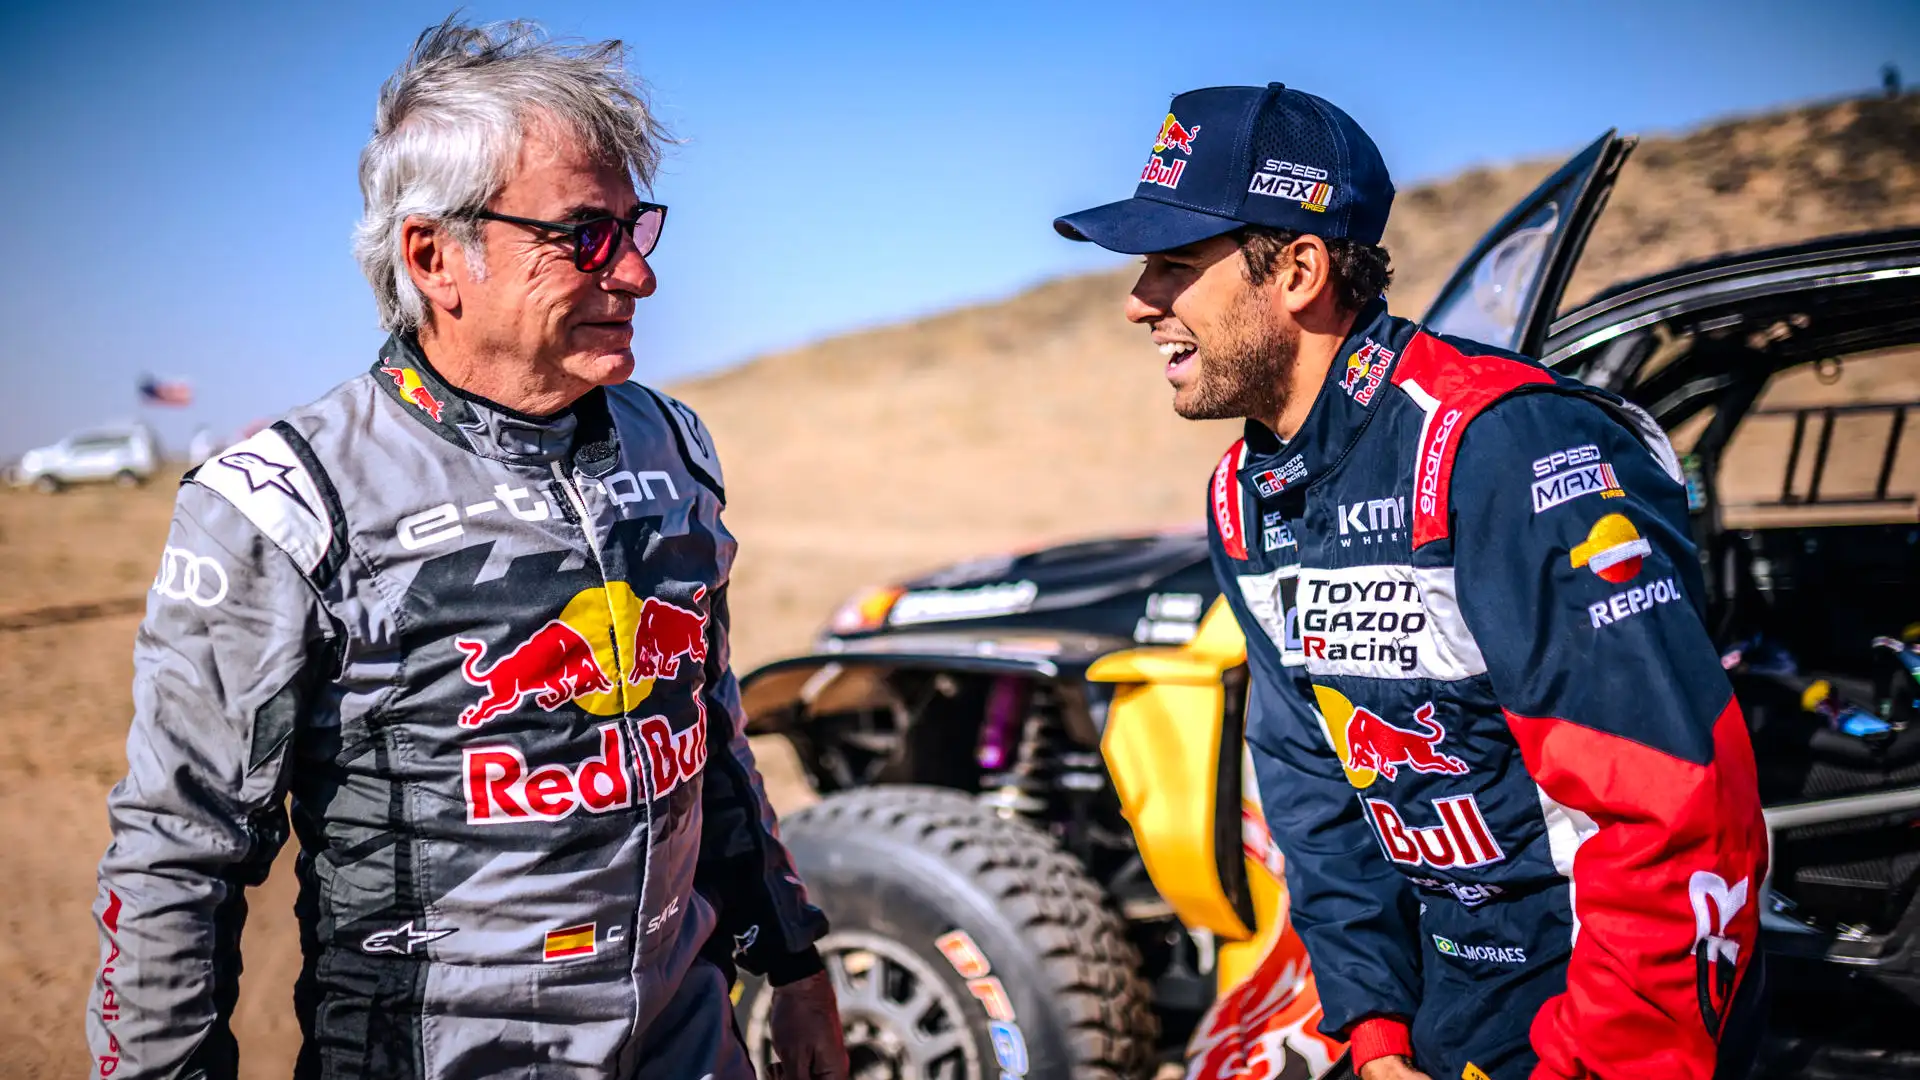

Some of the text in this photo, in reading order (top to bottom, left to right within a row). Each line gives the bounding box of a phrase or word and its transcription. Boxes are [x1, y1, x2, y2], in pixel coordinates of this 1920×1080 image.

[1147, 157, 1186, 188] Bull
[1263, 159, 1328, 180] SPEED
[1252, 174, 1313, 199] MAX
[1300, 201, 1326, 213] TIRES
[1355, 347, 1395, 406] Red Bull
[1273, 453, 1304, 474] TOYOTA
[1420, 409, 1462, 516] sparco
[1533, 444, 1601, 478] SPEED
[1260, 478, 1283, 494] GR
[1536, 468, 1603, 508] MAX
[1600, 488, 1626, 499] TIRES
[1340, 531, 1407, 547] WHEE
[1588, 577, 1681, 628] REPSOL
[1304, 609, 1426, 633] GAZOO
[1303, 635, 1418, 671] Racing
[466, 727, 628, 822] Red
[1370, 797, 1500, 866] Bull
[606, 915, 625, 943] C.
[102, 938, 120, 1021] Audi
